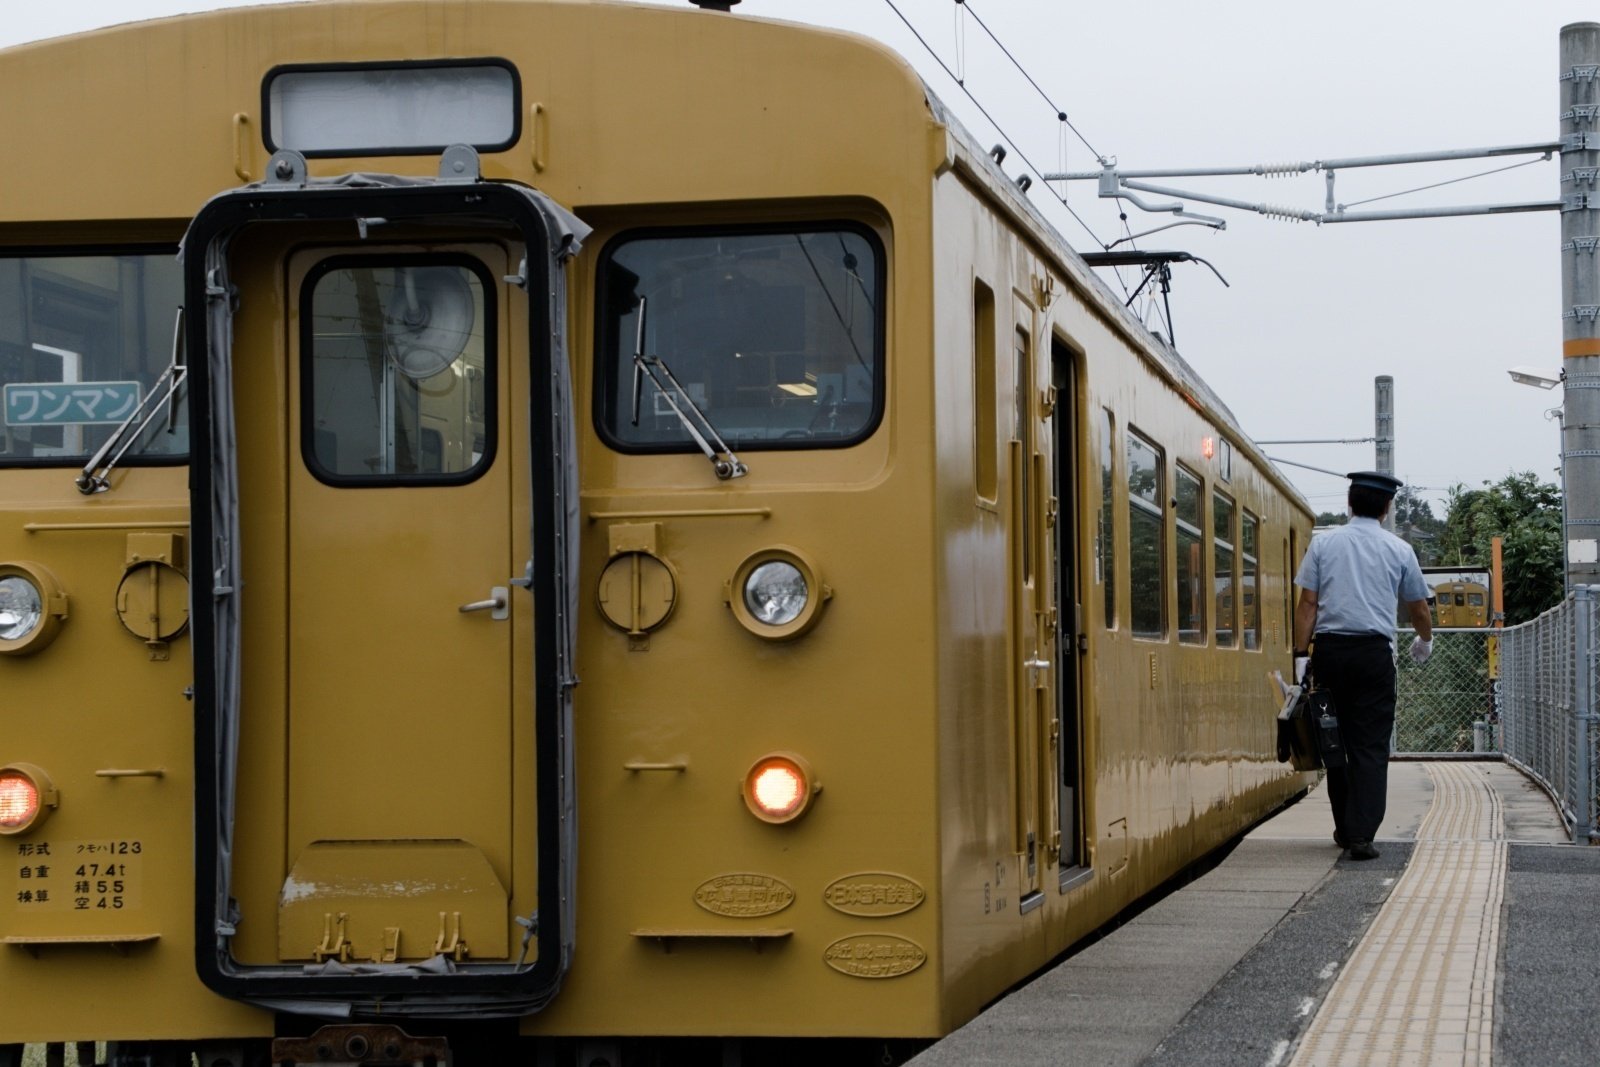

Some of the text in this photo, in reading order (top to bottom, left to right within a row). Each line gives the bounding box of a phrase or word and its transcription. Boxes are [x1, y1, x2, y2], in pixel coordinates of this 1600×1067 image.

[10, 388, 135, 420] ワンマン
[18, 841, 142, 856] 形式 クモハ123
[20, 865, 50, 878] 自重
[97, 881, 124, 893] 5.5
[74, 896, 124, 910] 空 4.5
